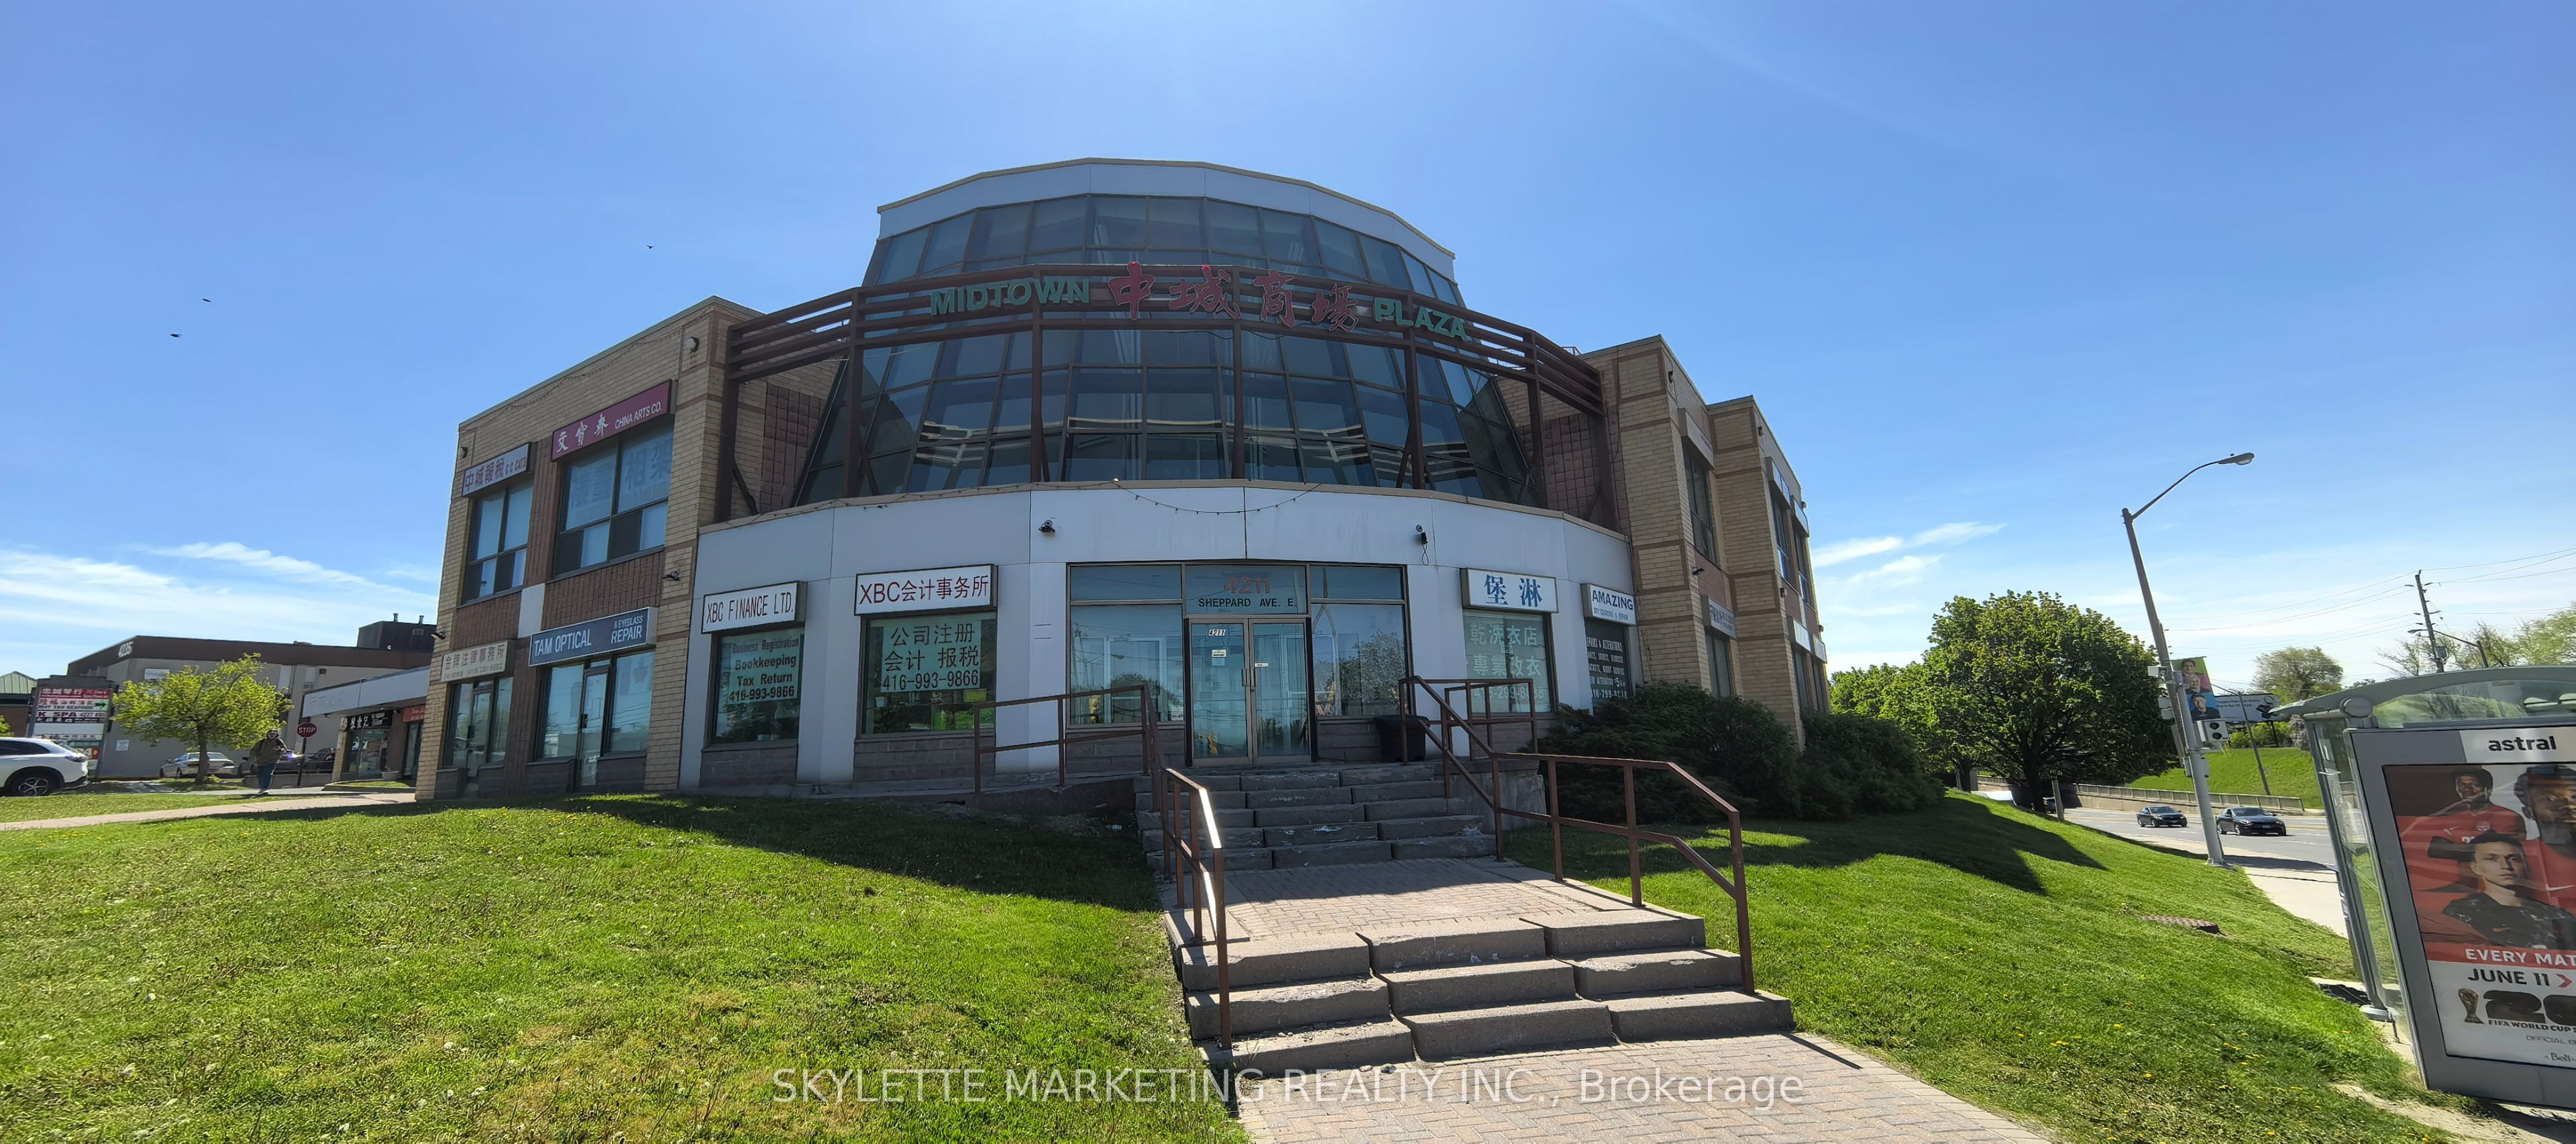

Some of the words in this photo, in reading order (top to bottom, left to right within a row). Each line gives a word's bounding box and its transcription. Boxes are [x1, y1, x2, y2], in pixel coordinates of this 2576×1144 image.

[930, 277, 1090, 315] MIDTOWN
[1375, 297, 1469, 342] PLAZA
[615, 413, 633, 429] CHINA
[633, 405, 650, 421] ARTS
[651, 401, 662, 414] CO.
[859, 575, 989, 605] XBC会计事务所
[1224, 576, 1271, 594] 4211
[706, 602, 724, 623] XBC
[729, 594, 769, 621] FINANCE
[773, 592, 794, 615] LTD.
[1198, 598, 1250, 607] SHEPPARD
[1259, 598, 1281, 607] AVE.
[1287, 598, 1297, 607] E.
[1593, 590, 1633, 610] AMAZING
[618, 615, 643, 628] EYEGLASS
[534, 637, 552, 656] TAM
[555, 629, 592, 652] OPTICAL
[610, 625, 643, 644] REPAIR
[890, 623, 975, 647] 公司注册
[731, 642, 758, 654] Business
[761, 638, 799, 652] Registration
[735, 654, 796, 670] Bookkeeping
[884, 649, 926, 672] 会计
[937, 645, 979, 668] 报税
[737, 676, 755, 687] Tax
[761, 673, 792, 684] Return
[882, 670, 978, 691] 416-993-9866
[729, 686, 795, 702] 416-993-9866
[2488, 735, 2557, 751] astral
[2465, 949, 2527, 964] EVERY
[2534, 953, 2576, 966] MAT
[2467, 968, 2527, 985] JUNE
[2533, 972, 2550, 986] 11
[2488, 1019, 2510, 1027] FIFA
[2510, 1021, 2548, 1030] WORLD
[2526, 1035, 2567, 1044] OFFICIAL
